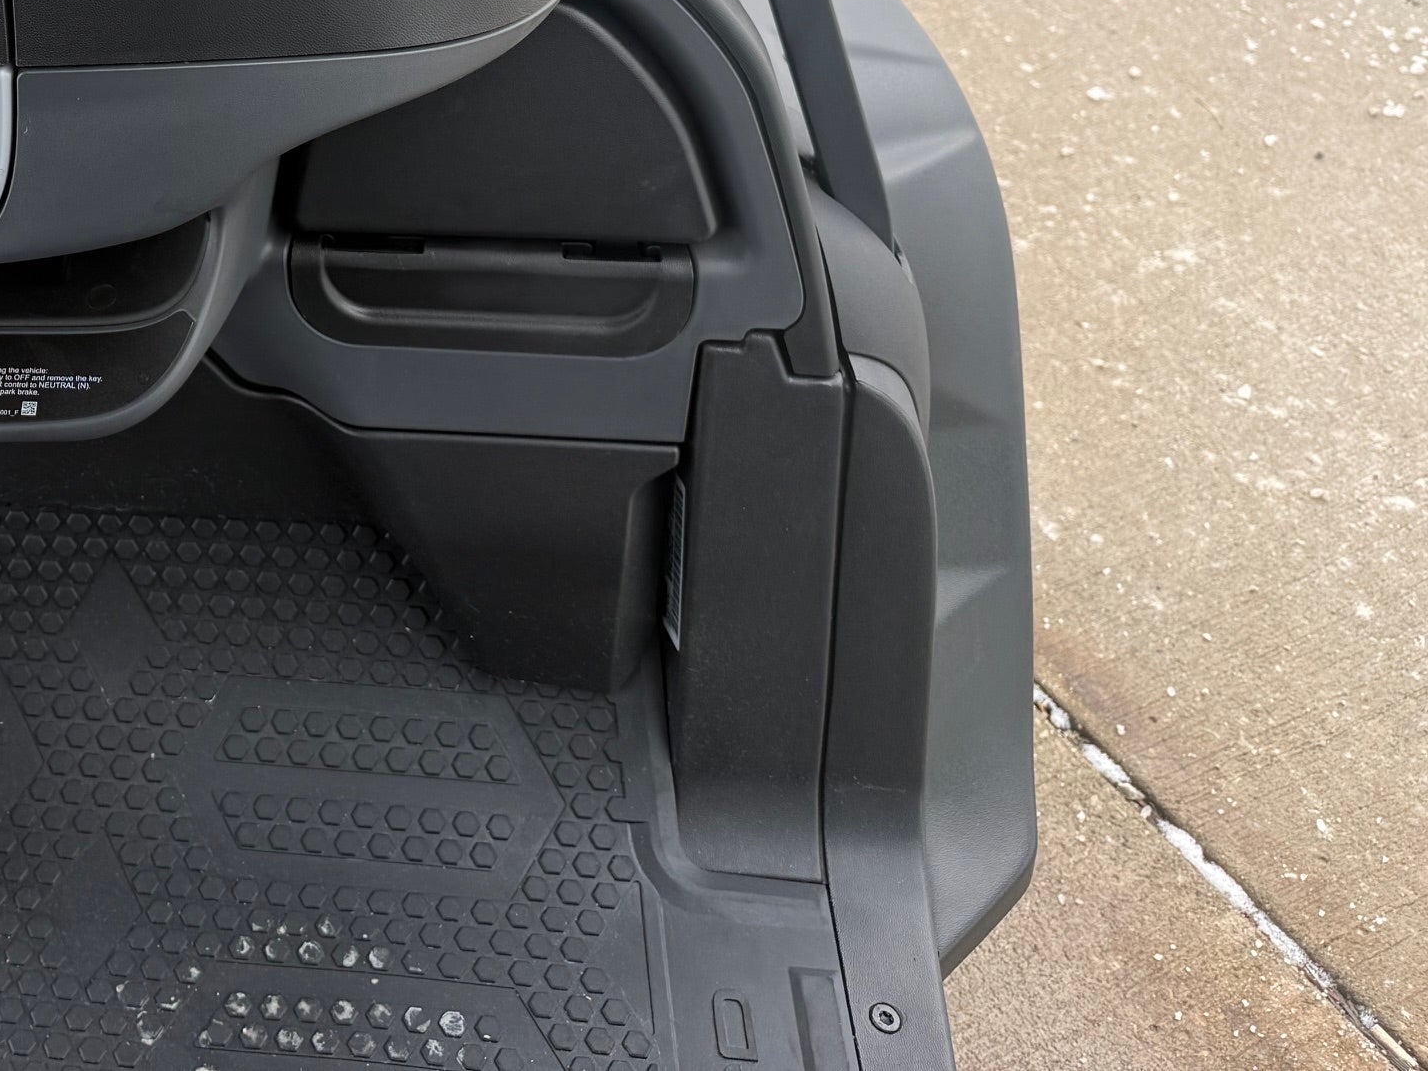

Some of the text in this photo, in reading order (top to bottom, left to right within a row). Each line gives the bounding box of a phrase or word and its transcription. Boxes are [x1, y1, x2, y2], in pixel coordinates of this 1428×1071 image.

[88, 376, 103, 384] key.
[77, 383, 91, 391] (N).
[0, 389, 15, 397] park
